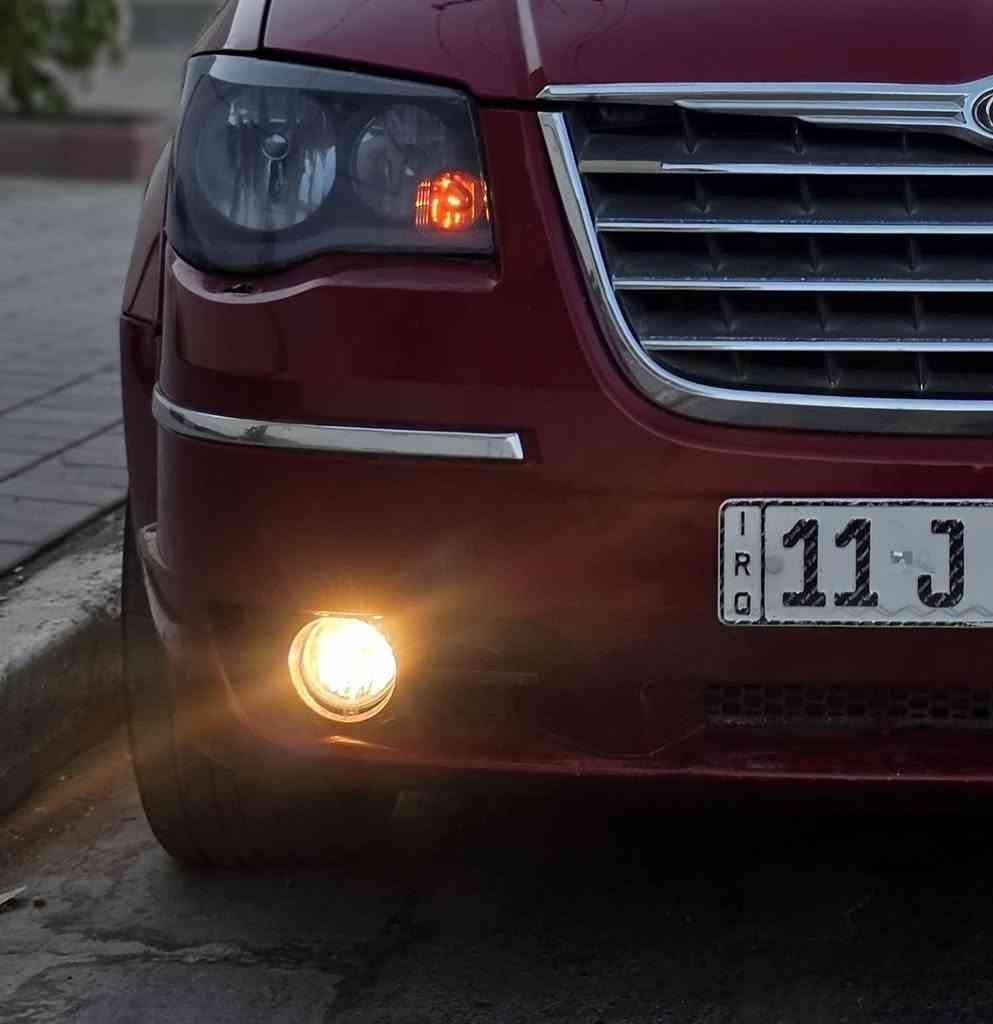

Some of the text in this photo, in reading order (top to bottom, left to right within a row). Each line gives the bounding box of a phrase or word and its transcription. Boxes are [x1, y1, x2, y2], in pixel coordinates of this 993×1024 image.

[734, 511, 751, 615] IRQ
[782, 518, 879, 607] 11
[916, 518, 966, 608] J
